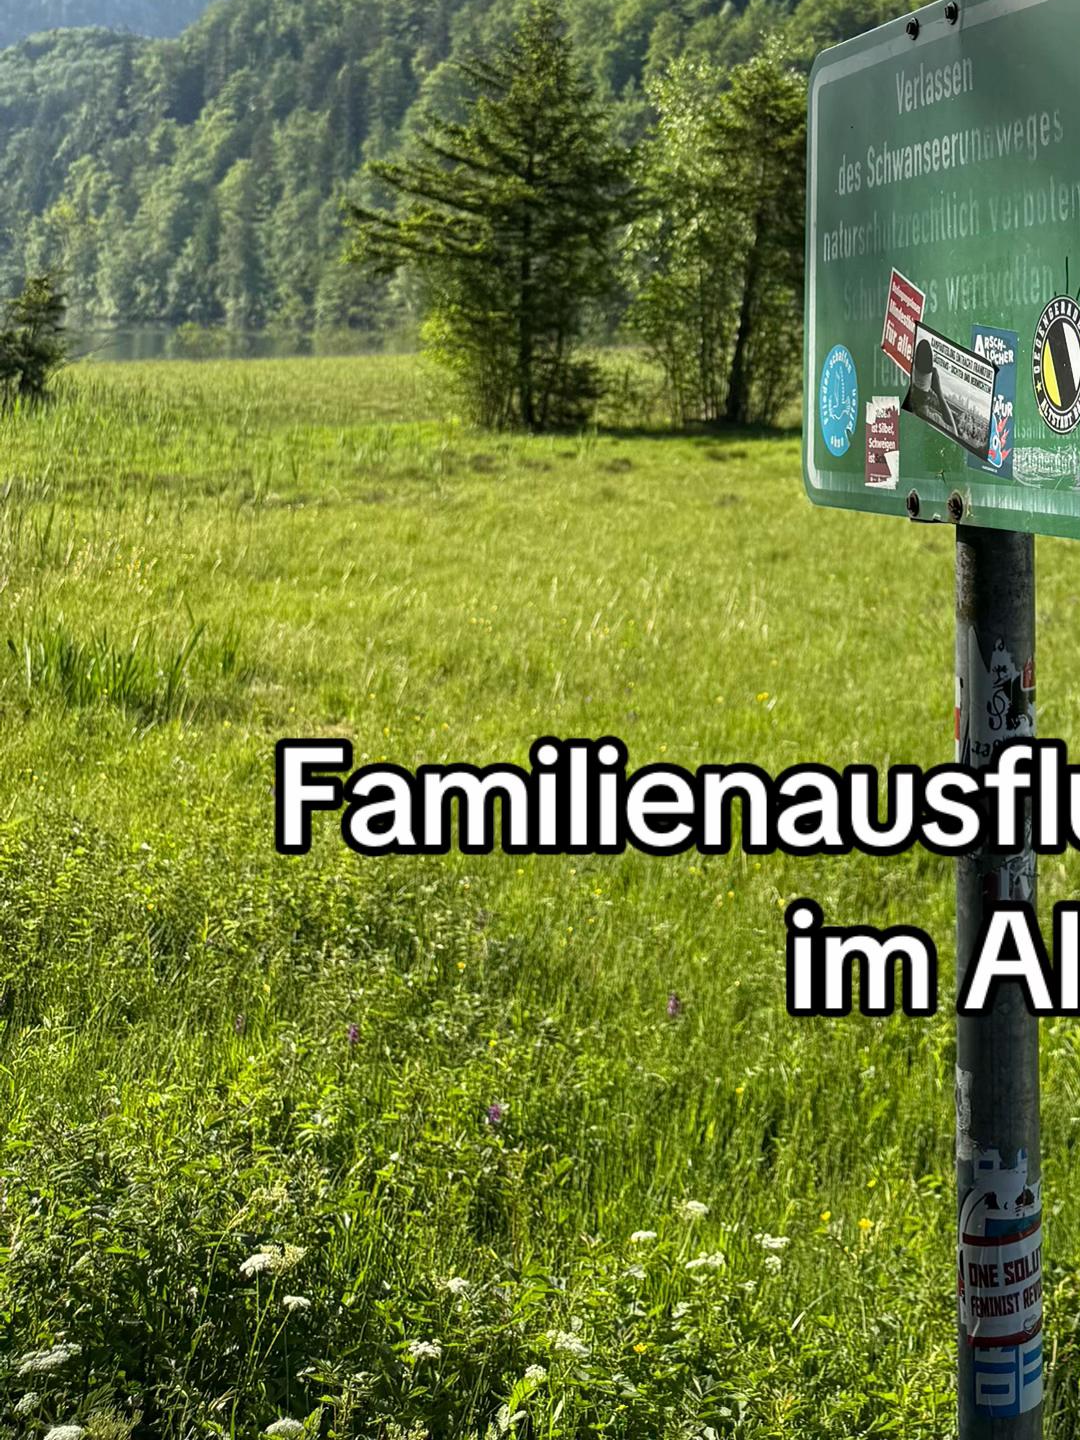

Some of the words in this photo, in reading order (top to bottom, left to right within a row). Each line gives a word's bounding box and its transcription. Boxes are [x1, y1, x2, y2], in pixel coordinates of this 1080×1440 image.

[896, 57, 974, 115] Verlassen
[838, 154, 862, 196] des
[886, 320, 898, 346] für
[974, 334, 1006, 358] ARSCH-
[1040, 398, 1074, 429] ALTSTADT
[868, 437, 896, 452] Schweigen
[968, 1262, 1000, 1288] ONE
[970, 1292, 1020, 1318] FEMINIST
